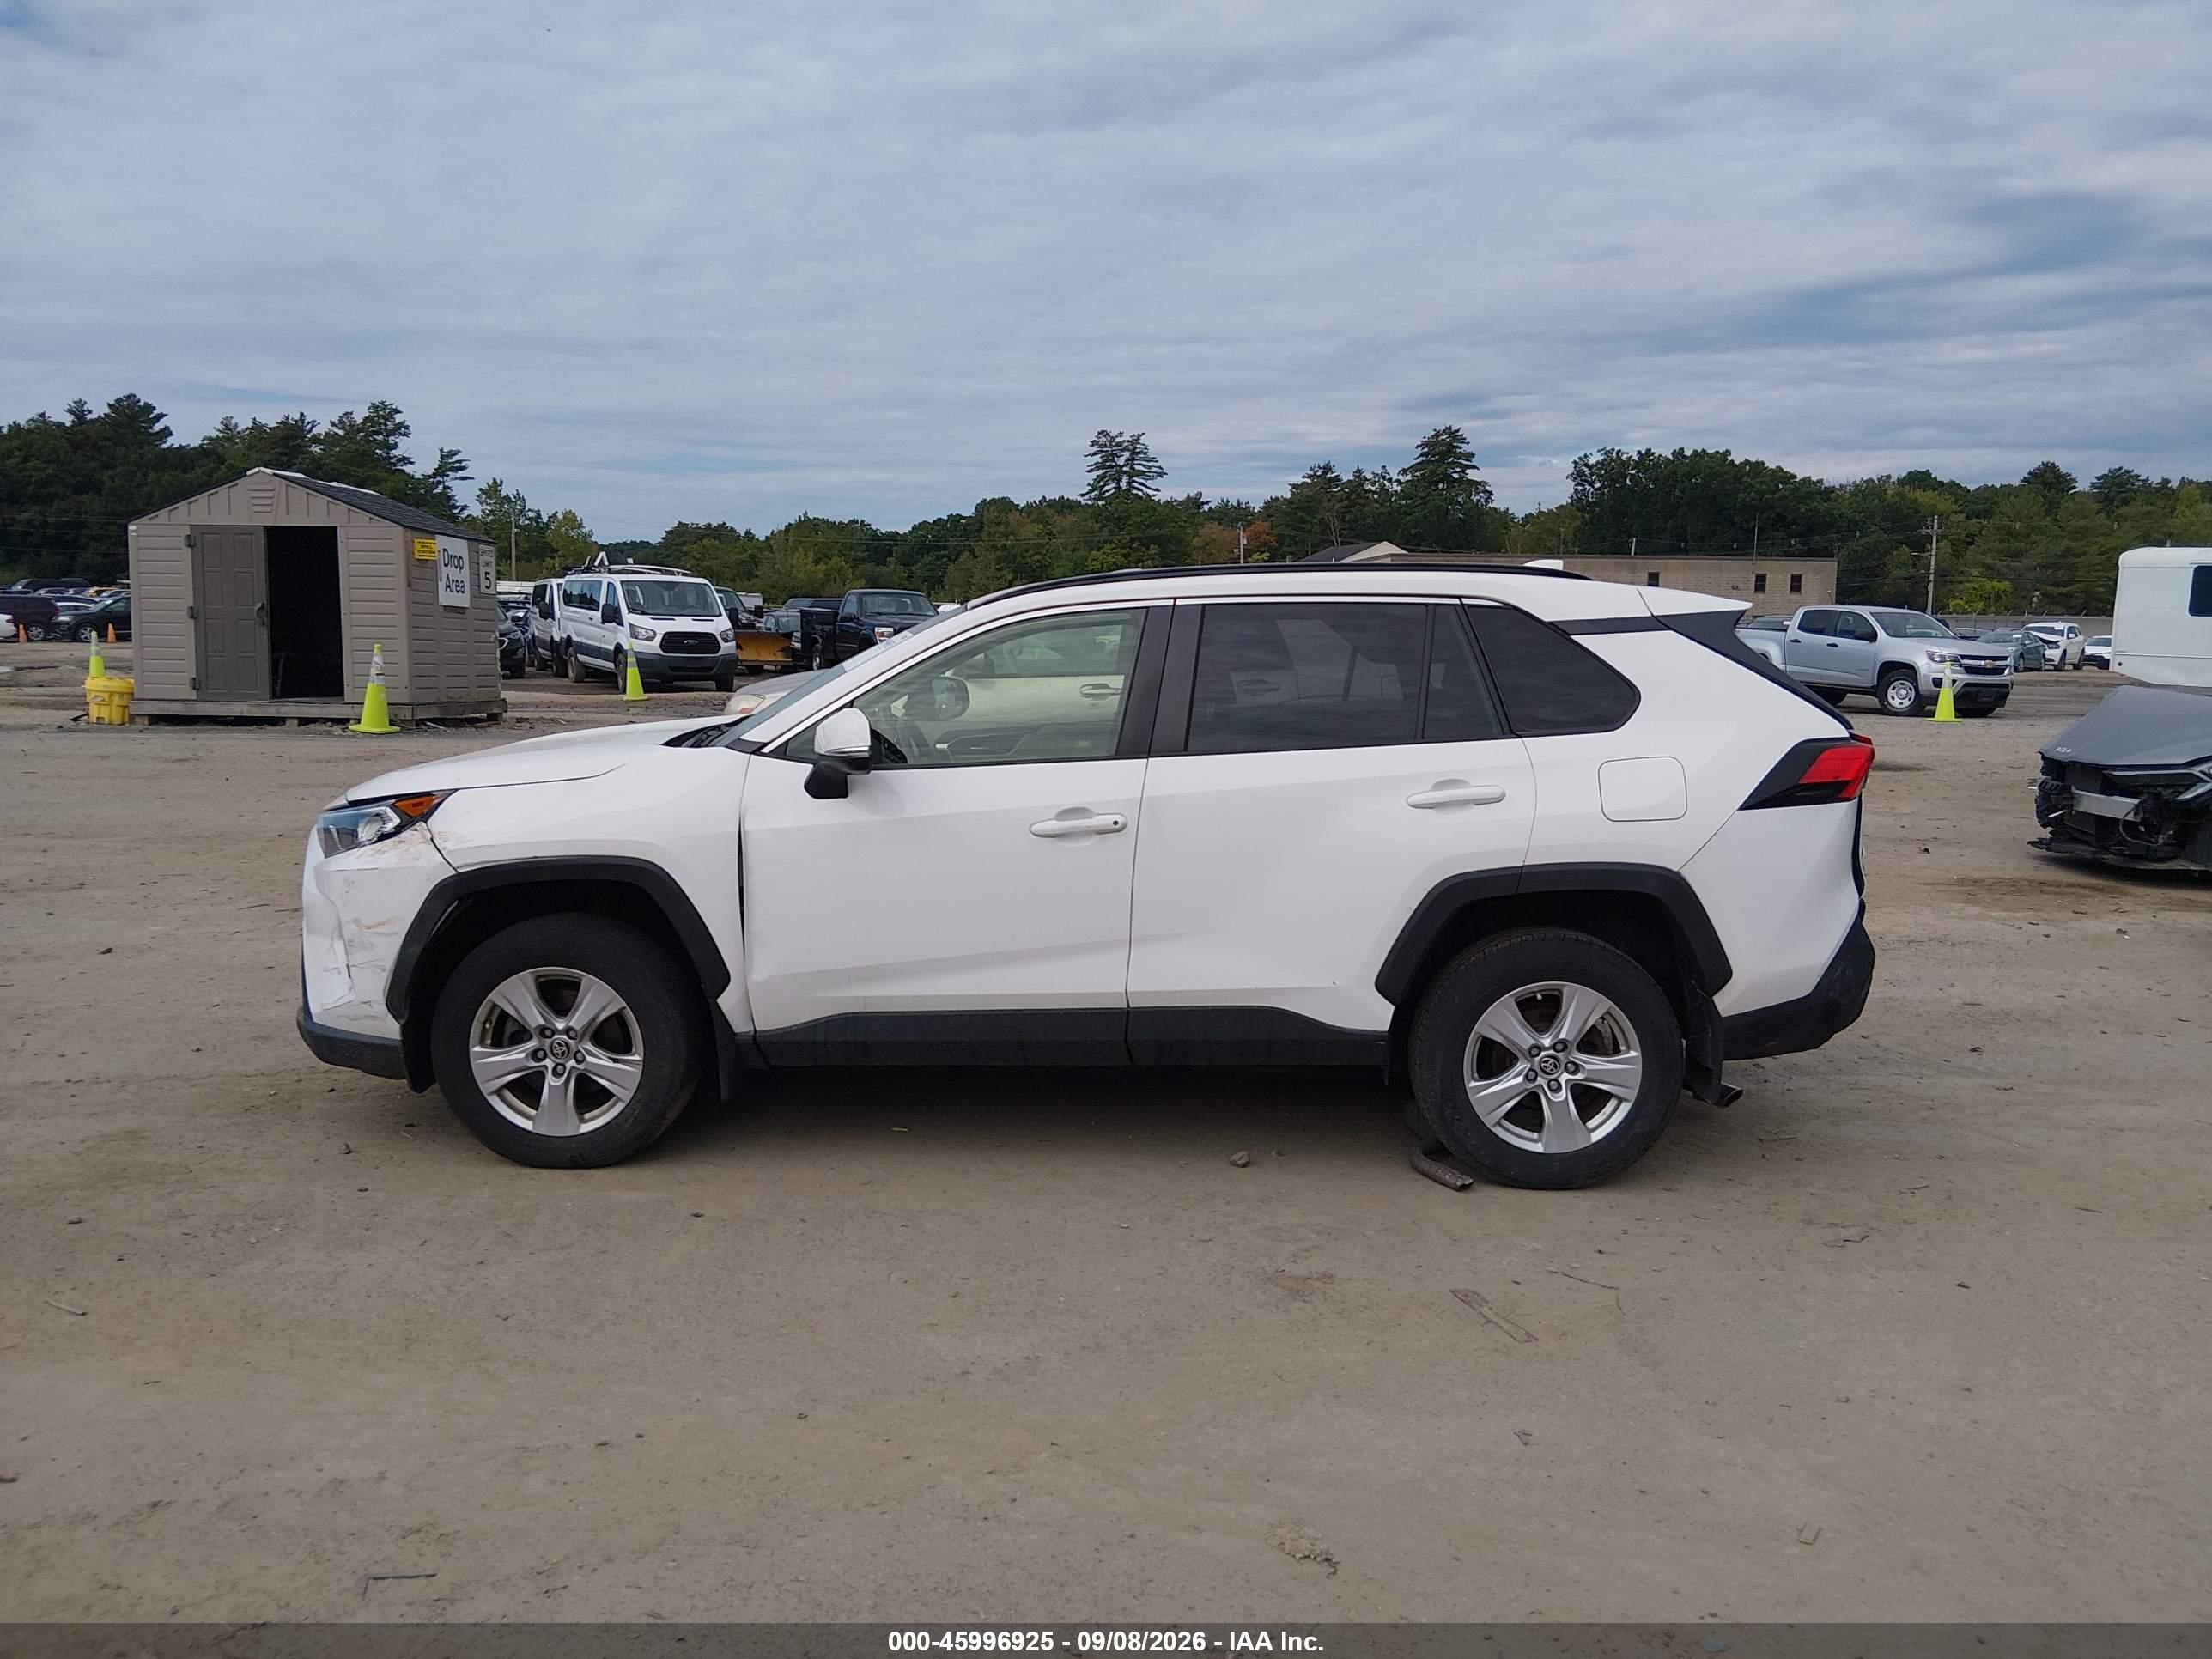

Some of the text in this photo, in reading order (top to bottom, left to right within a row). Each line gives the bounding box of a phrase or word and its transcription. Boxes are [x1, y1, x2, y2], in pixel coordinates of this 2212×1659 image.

[442, 548, 465, 574] Drop
[445, 574, 465, 593] Area
[484, 571, 492, 590] 5
